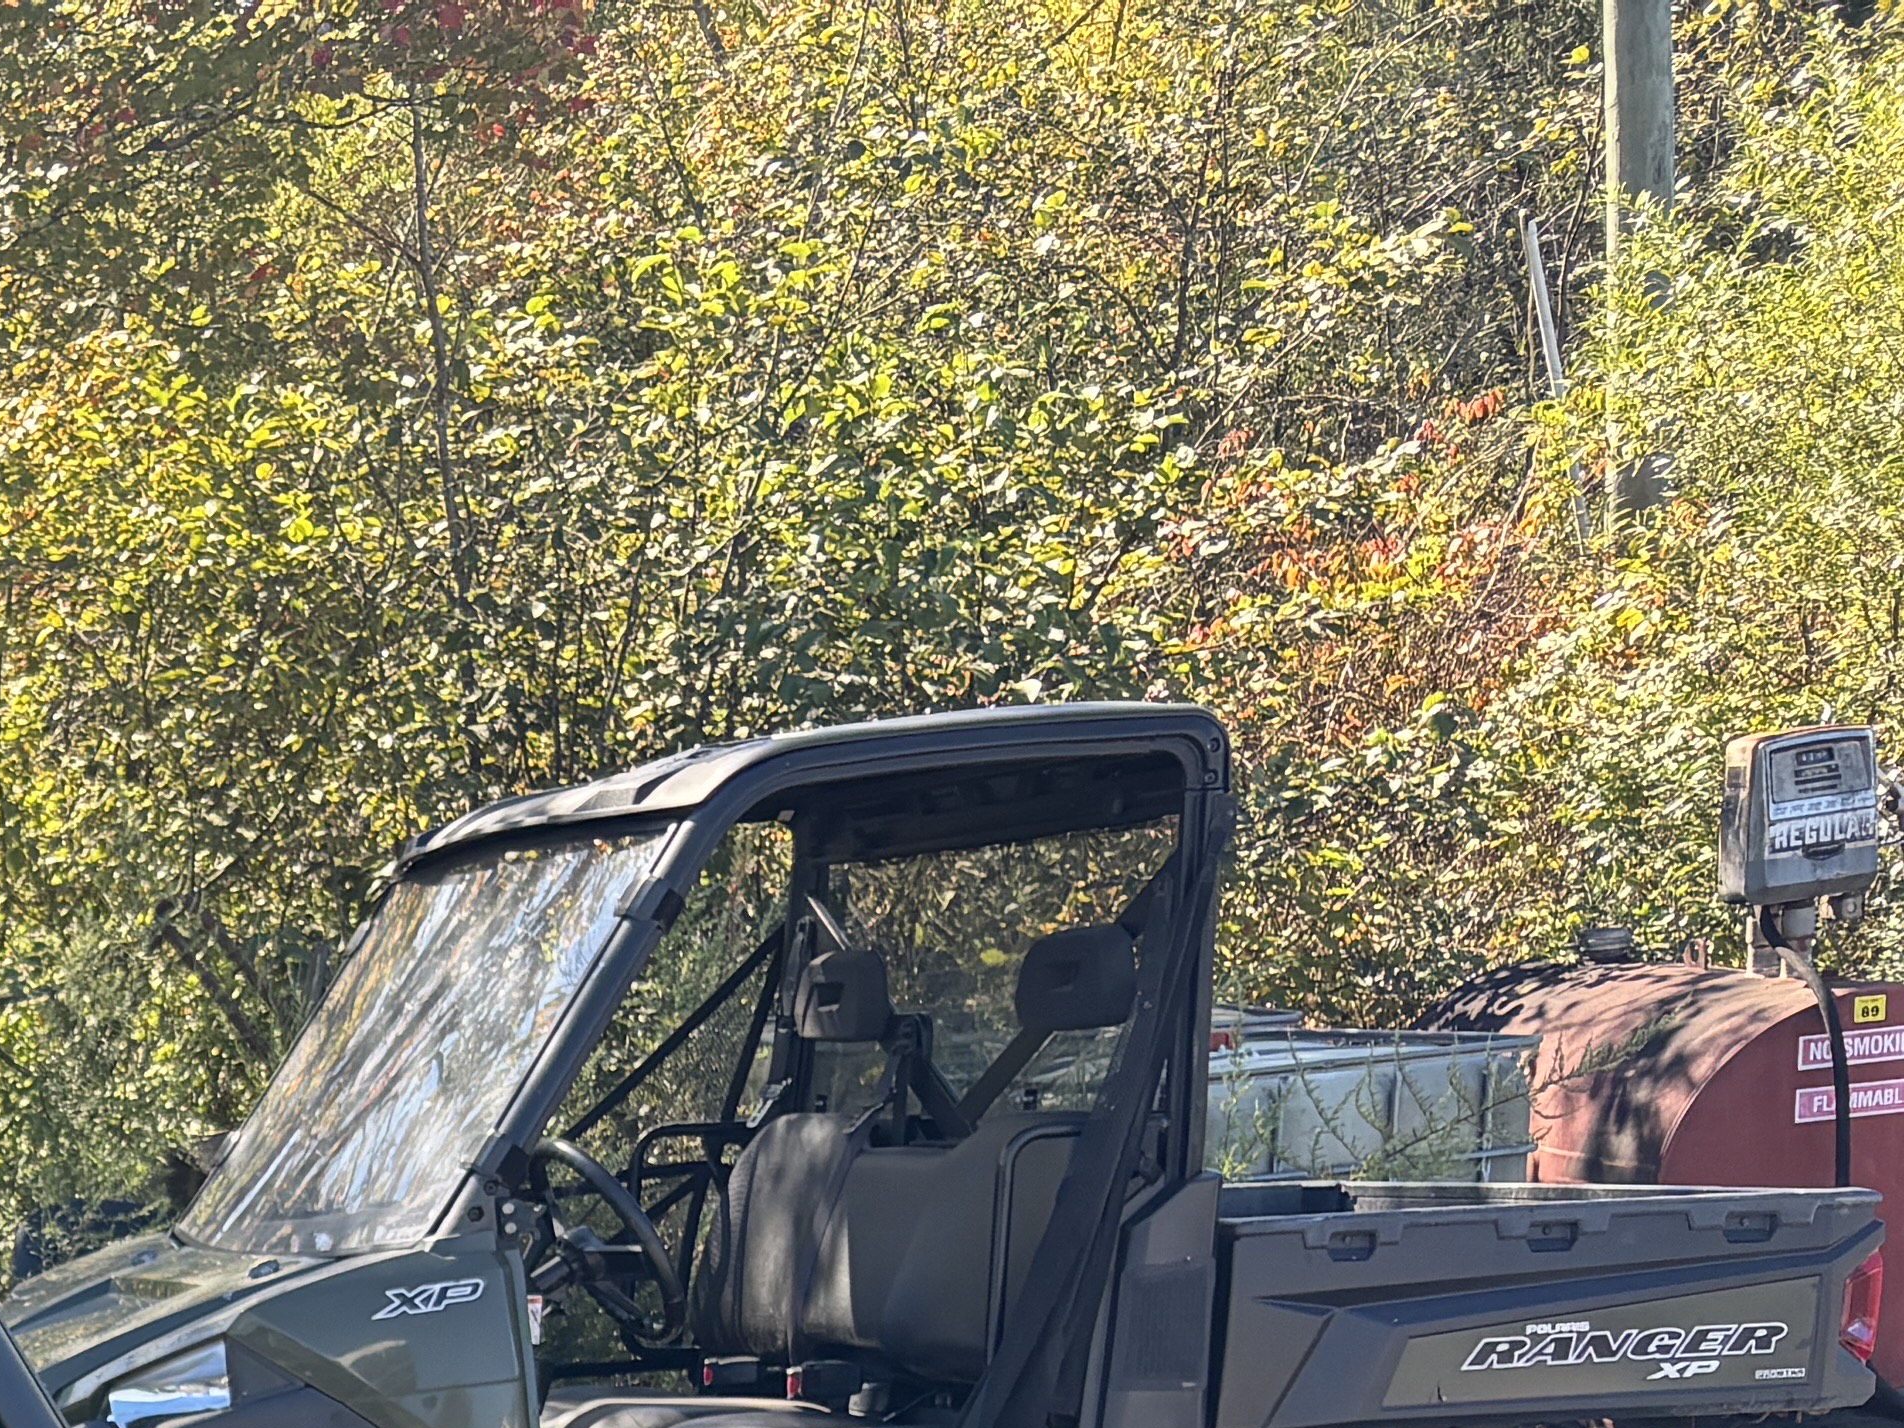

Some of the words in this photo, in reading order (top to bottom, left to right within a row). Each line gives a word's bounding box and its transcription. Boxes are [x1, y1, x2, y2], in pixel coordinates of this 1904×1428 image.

[1861, 1005, 1880, 1018] 89
[371, 1278, 485, 1320] XP
[1460, 1322, 1789, 1371] RANGER
[1646, 1359, 1720, 1380] XP
